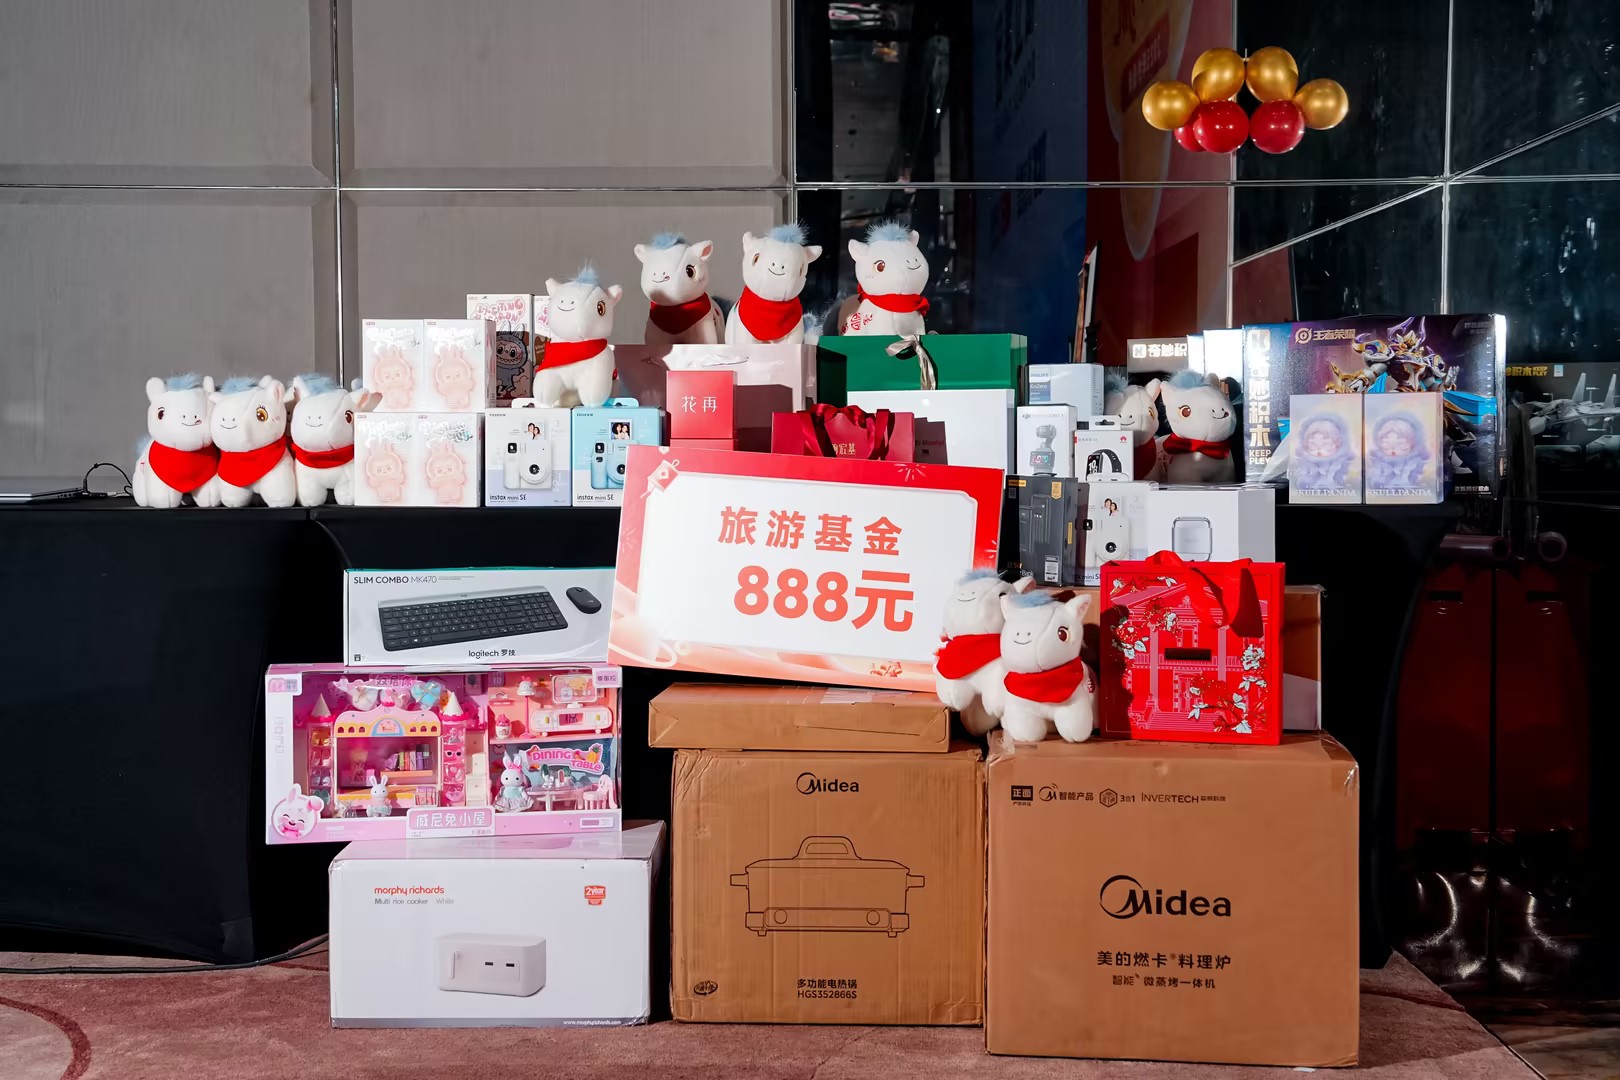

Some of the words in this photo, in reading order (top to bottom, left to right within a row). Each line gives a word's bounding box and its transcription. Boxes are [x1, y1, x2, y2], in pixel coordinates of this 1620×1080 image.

[681, 395, 718, 413] 花再
[717, 505, 903, 557] 旅游基金
[353, 576, 374, 584] SLIM
[375, 576, 409, 584] COMBO
[410, 575, 438, 584] MK470
[733, 565, 915, 632] 888元
[468, 650, 499, 659] logitech
[796, 772, 860, 795] Midea
[1059, 791, 1094, 801] 智能产品
[1141, 792, 1199, 804] INVERTECH
[374, 885, 408, 896] morphy
[409, 885, 445, 895] richards
[374, 897, 391, 905] Multi
[1100, 875, 1232, 920] Midea
[797, 978, 858, 989] 多功能电热锅
[1143, 976, 1216, 989] 微蒸烤一体机
